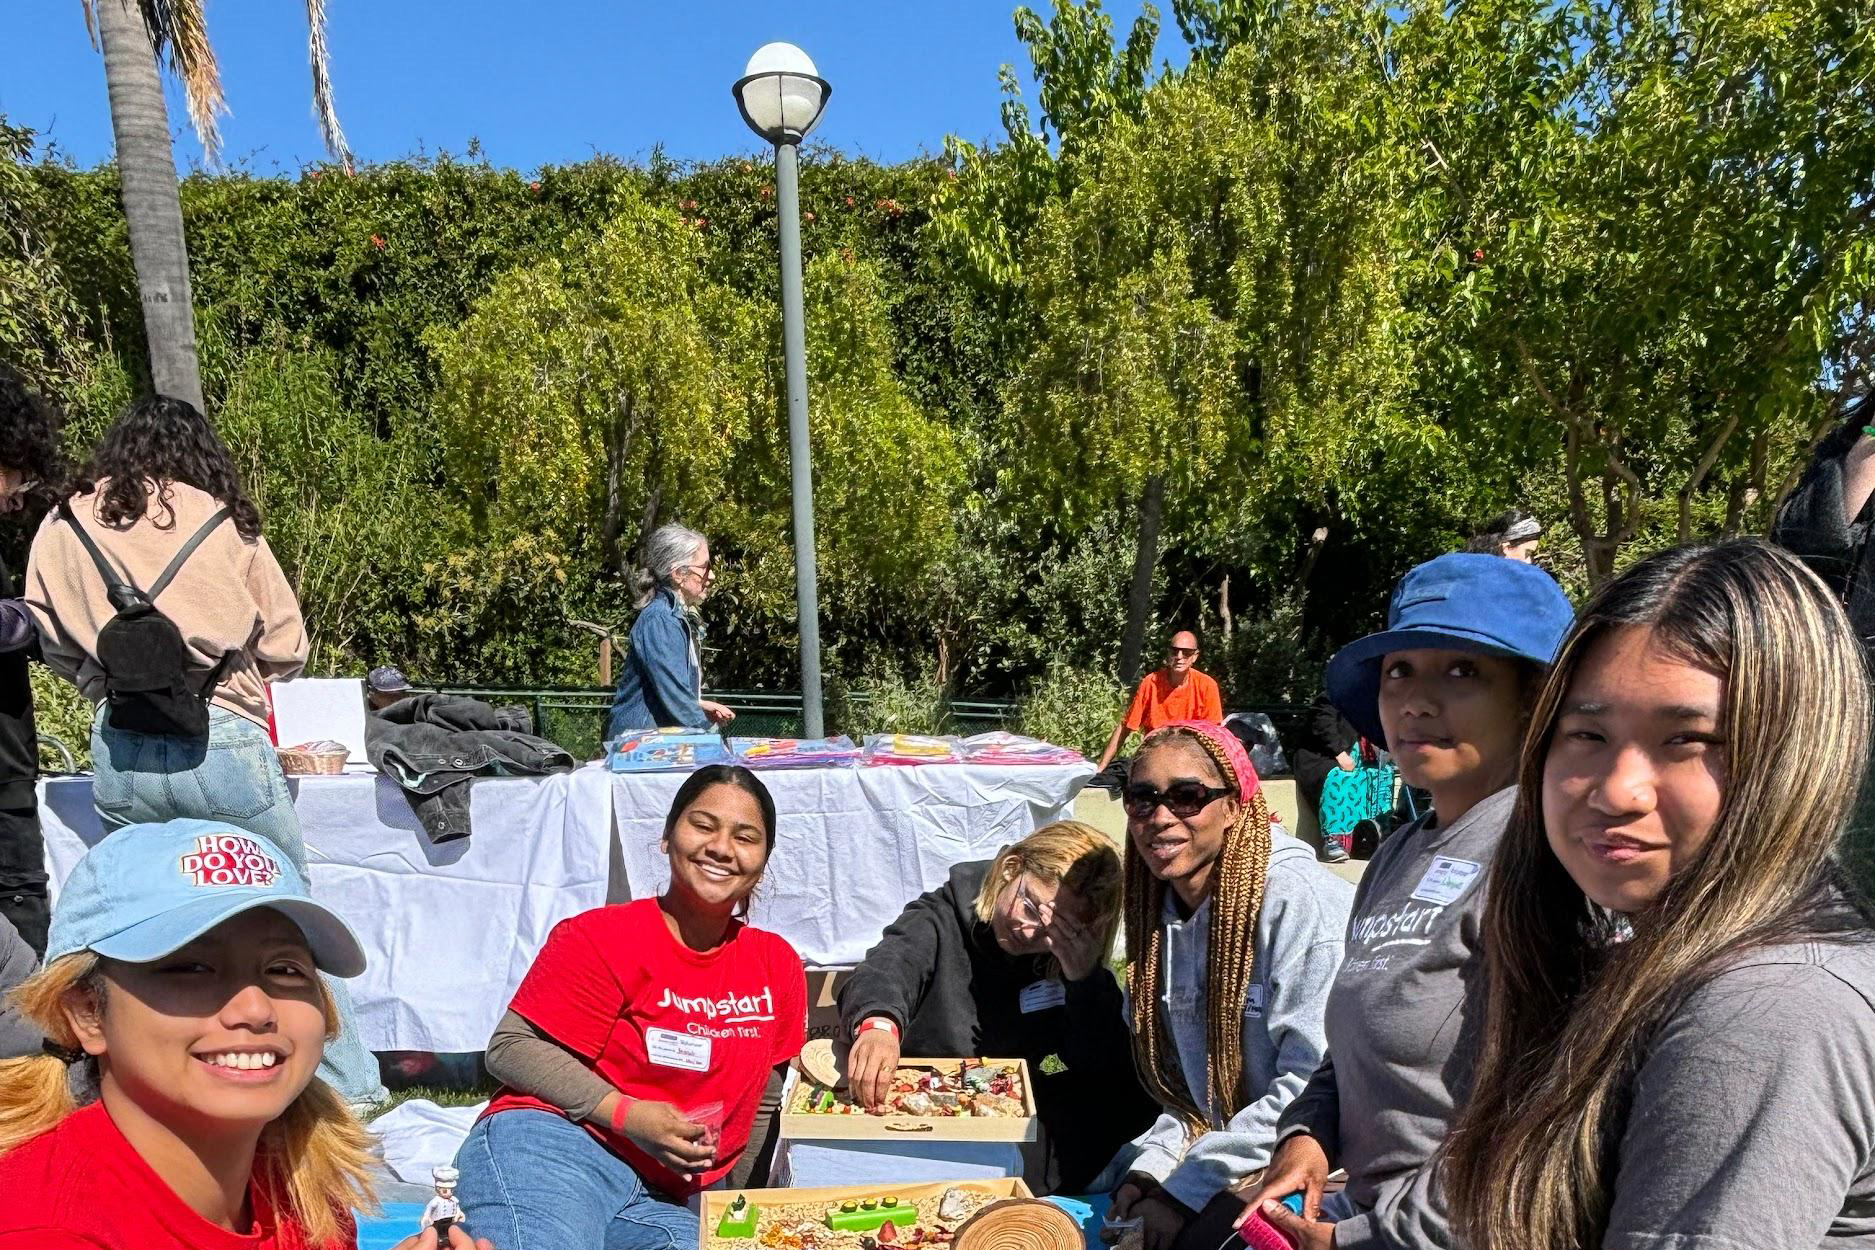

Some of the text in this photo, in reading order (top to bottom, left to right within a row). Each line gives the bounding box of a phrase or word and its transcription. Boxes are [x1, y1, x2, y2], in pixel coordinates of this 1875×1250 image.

[197, 836, 261, 854] HOW
[182, 853, 281, 875] DO YOU
[195, 868, 274, 886] LOVE?
[657, 985, 774, 1020] Jumpstart
